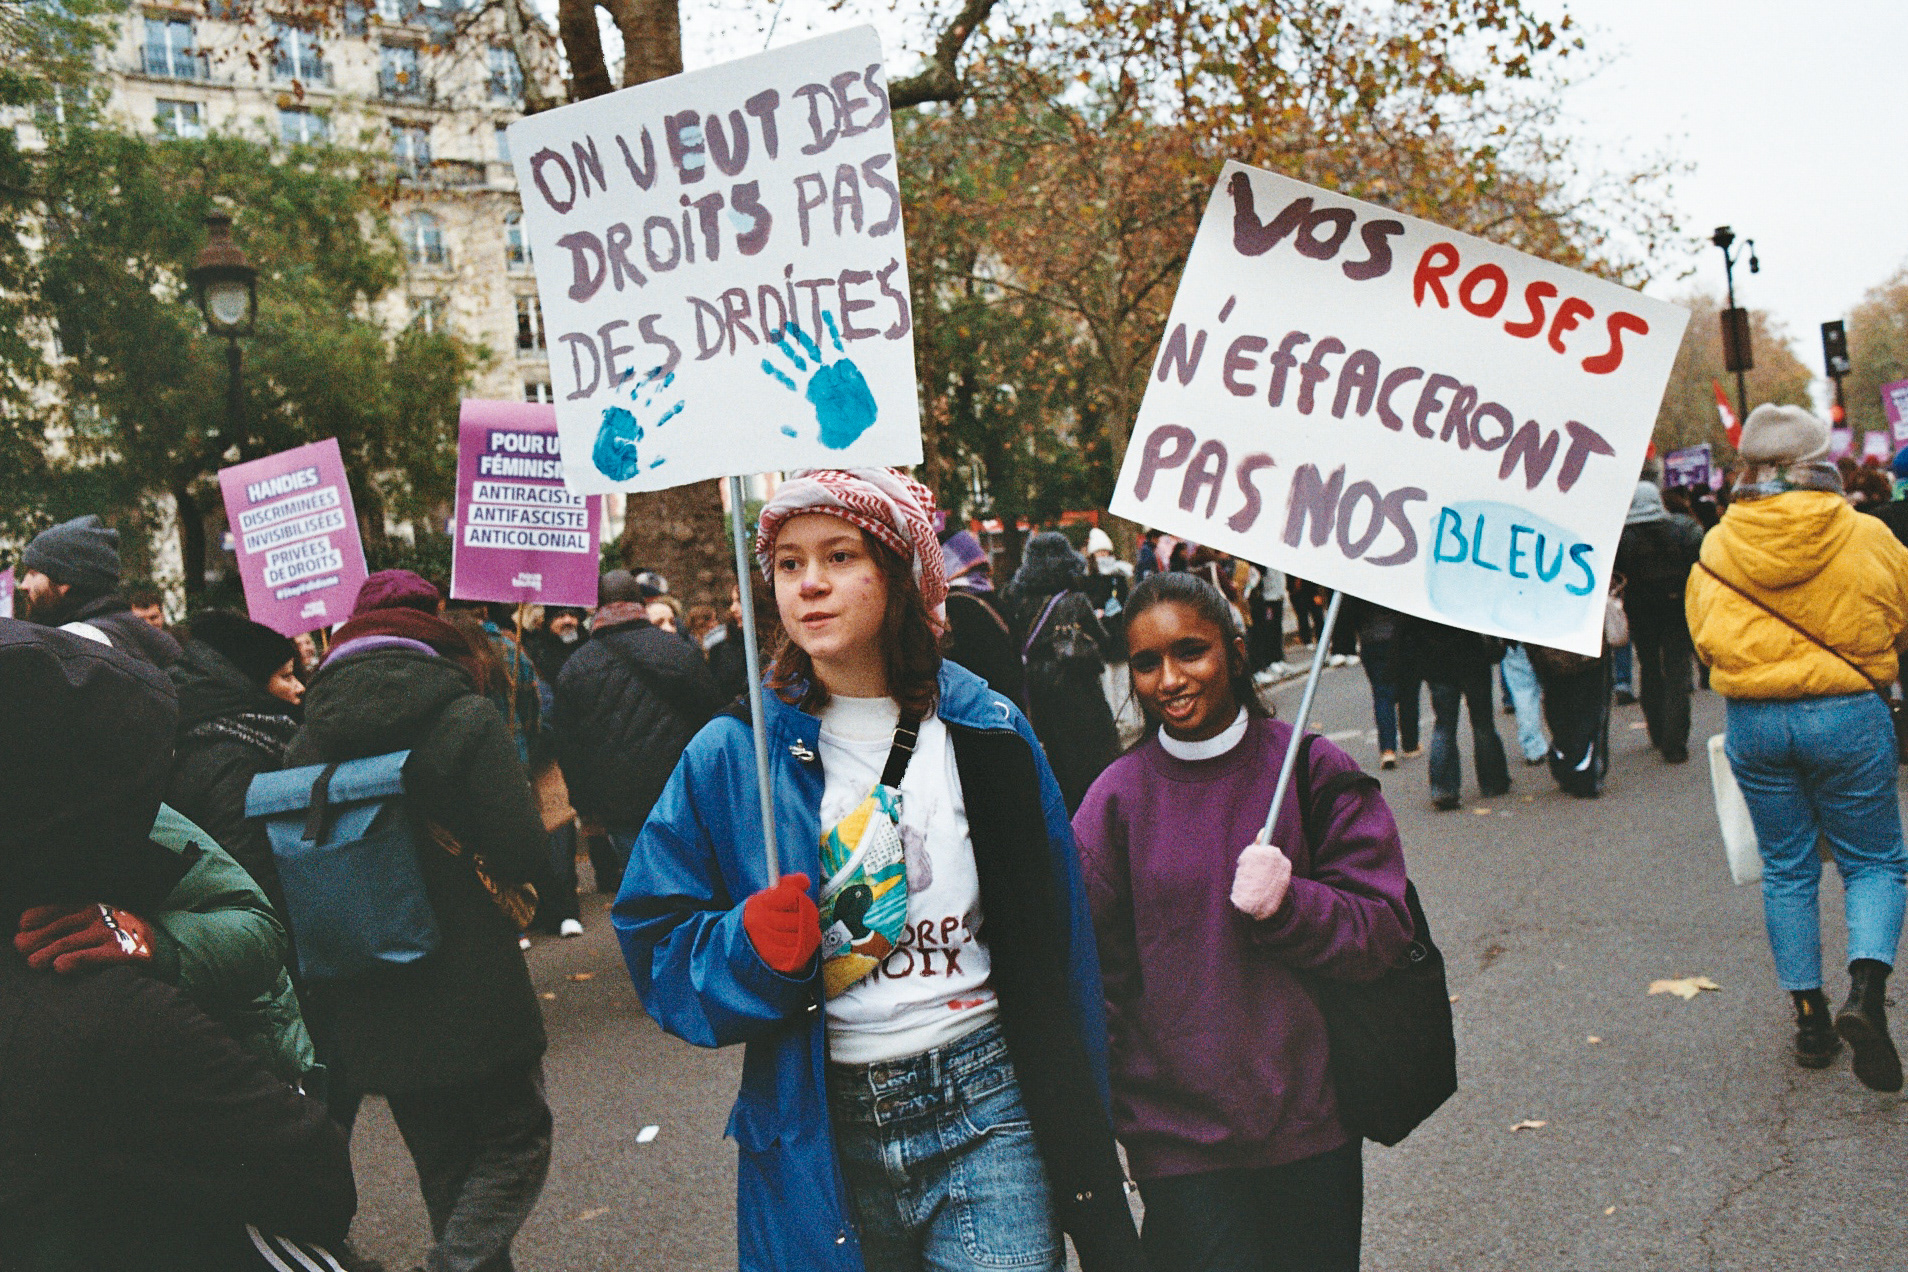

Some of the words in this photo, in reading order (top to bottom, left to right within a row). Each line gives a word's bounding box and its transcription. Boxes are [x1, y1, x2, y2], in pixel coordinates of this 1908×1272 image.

[530, 135, 607, 214] ON
[615, 88, 780, 191] VEUT
[793, 63, 891, 155] DES
[794, 153, 900, 247] PAS
[1227, 171, 1405, 280] VOS
[1413, 242, 1649, 374] ROSES
[558, 313, 683, 401] DES
[491, 432, 544, 454] POUR
[546, 435, 561, 455] U
[248, 467, 319, 503] HANDIES
[479, 485, 582, 505] ANTIRACISTE
[243, 490, 335, 528] DISCRIMINÉES
[474, 507, 585, 527] ANTIFASCISTE
[1134, 424, 1277, 533] PAS
[1281, 463, 1429, 567] NOS
[1433, 506, 1596, 596] BLEUS
[246, 511, 342, 549] INVISIBILISÉES
[470, 529, 586, 549] ANTICOLONIAL
[269, 567, 286, 582] DE
[287, 553, 338, 577] DROITS
[271, 539, 326, 566] PRIVÉES
[897, 916, 972, 949] ORPS
[861, 947, 965, 987] OIX
